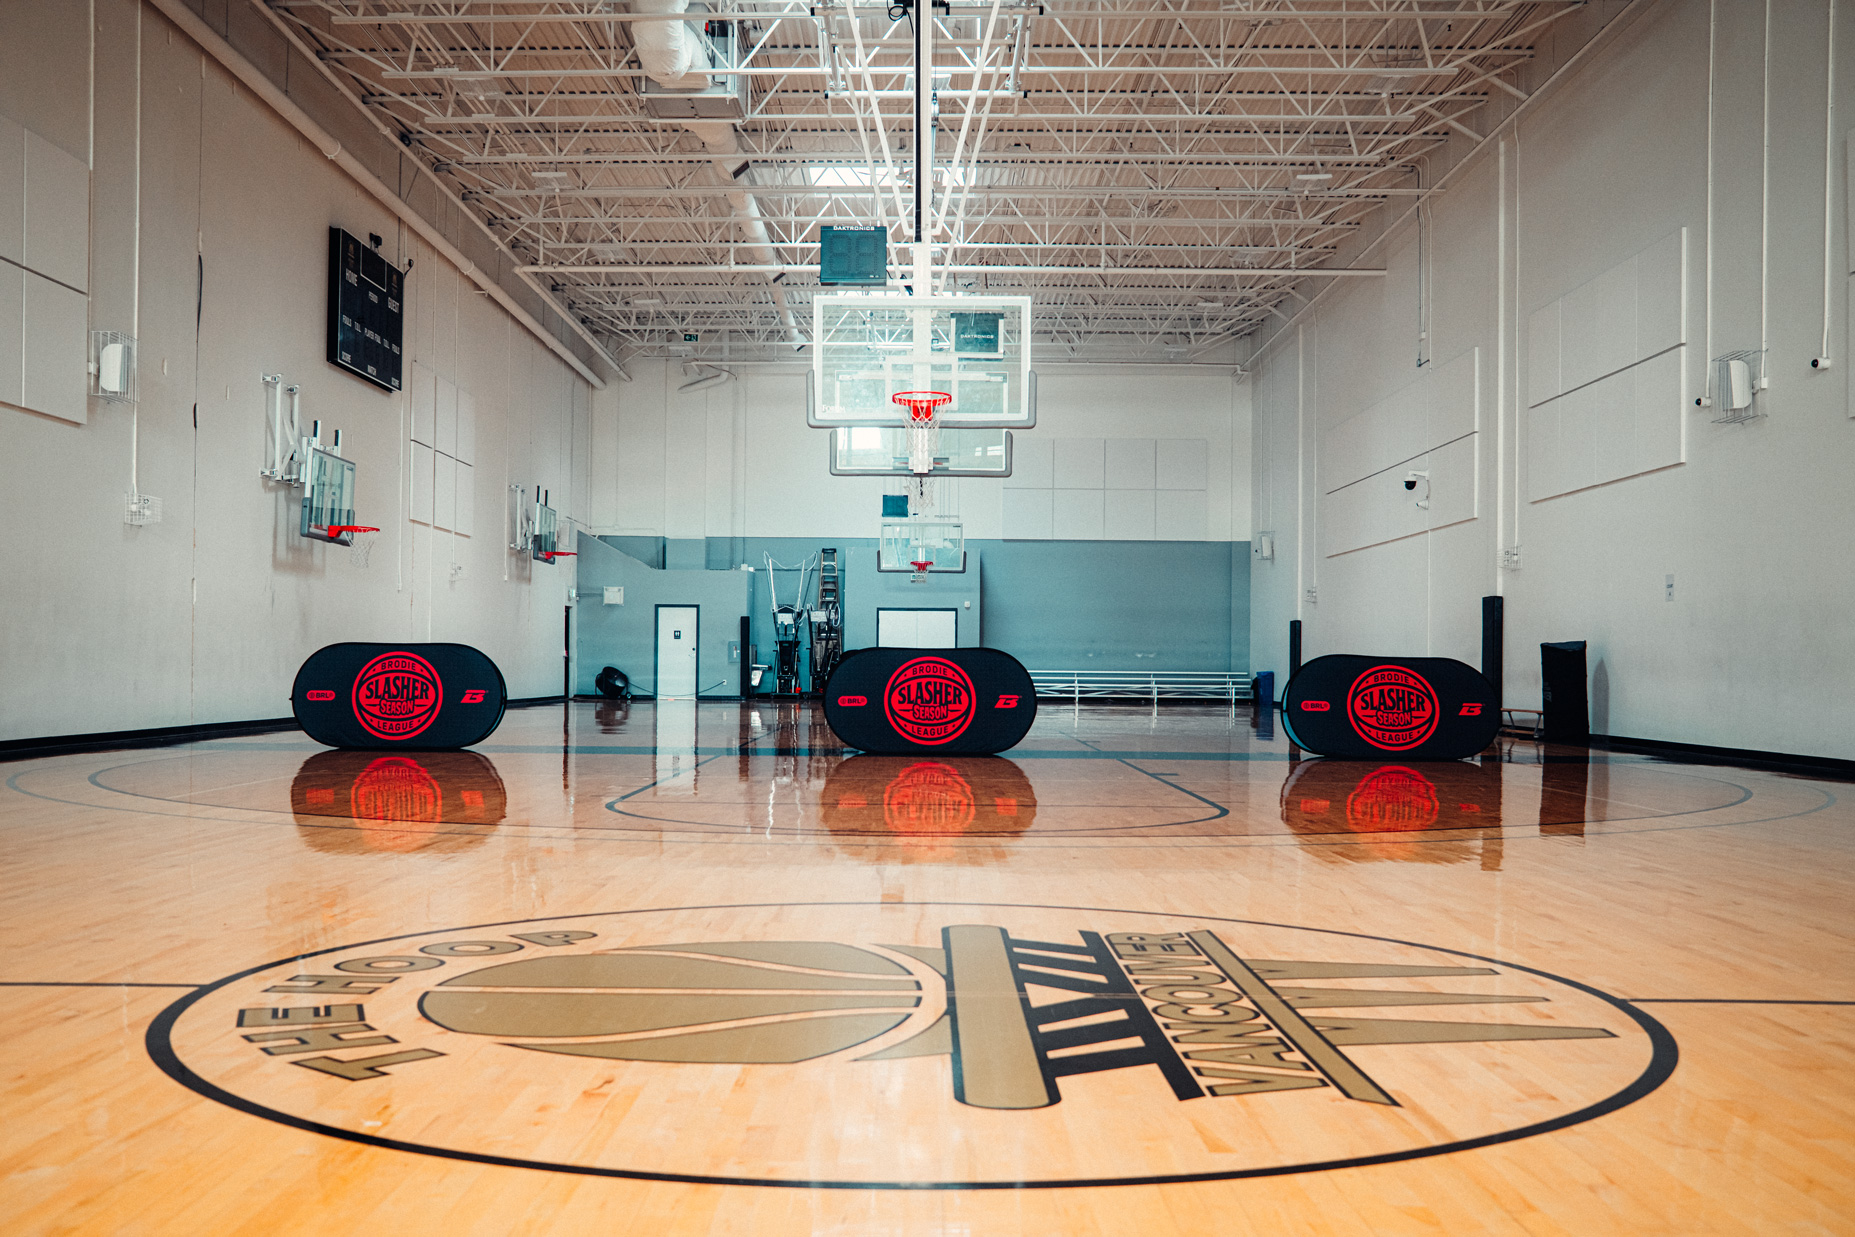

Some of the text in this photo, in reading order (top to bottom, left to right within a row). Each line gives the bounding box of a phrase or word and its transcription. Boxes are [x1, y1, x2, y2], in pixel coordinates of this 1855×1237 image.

[345, 268, 358, 287] HOME
[387, 296, 400, 313] GUEST
[381, 660, 416, 671] BRODIE
[912, 665, 948, 676] BRODIE
[1373, 673, 1410, 684] BRODIE
[365, 676, 430, 700] SLASHER
[897, 681, 963, 705] SLASHER
[380, 700, 414, 714] SEASON
[1360, 688, 1426, 712] SLASHER
[913, 705, 948, 720] SEASON
[1377, 711, 1412, 726] SEASON
[377, 720, 414, 731] LEAGUE
[911, 725, 949, 736] LEAGUE
[1375, 731, 1414, 742] LEAGUE
[236, 930, 598, 1082] THE HOOP
[1103, 931, 1331, 1097] VANCOUVER
